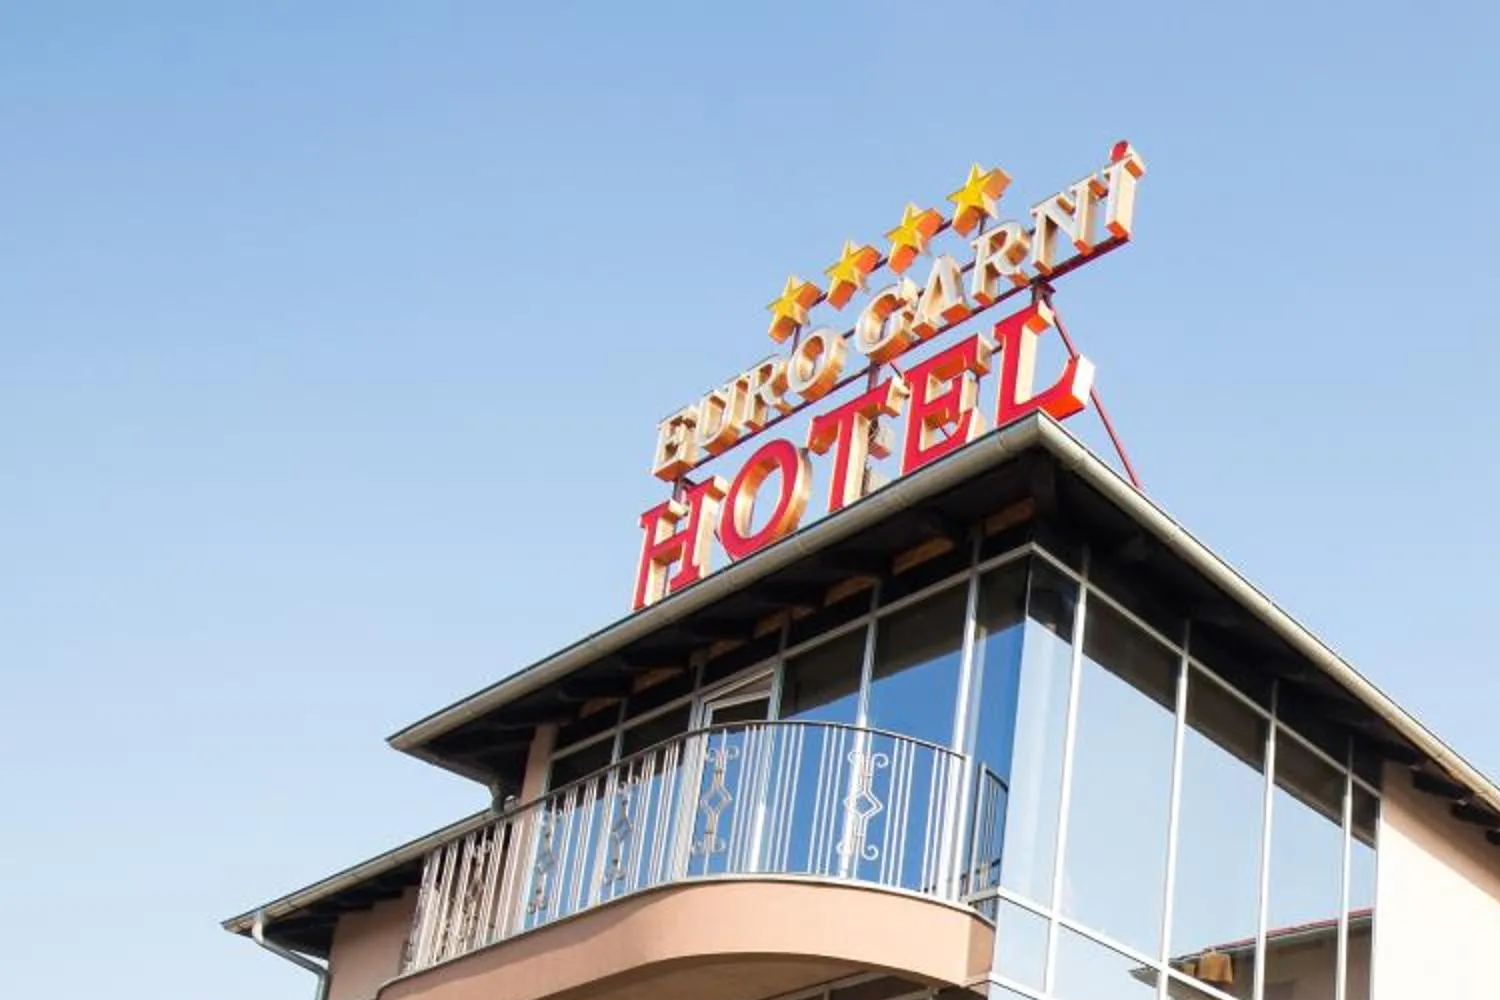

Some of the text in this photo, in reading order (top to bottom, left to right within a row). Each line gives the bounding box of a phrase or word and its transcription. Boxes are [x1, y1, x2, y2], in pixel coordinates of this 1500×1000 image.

[632, 301, 1095, 609] HOTEL
[651, 139, 1145, 481] EURO GARNI
